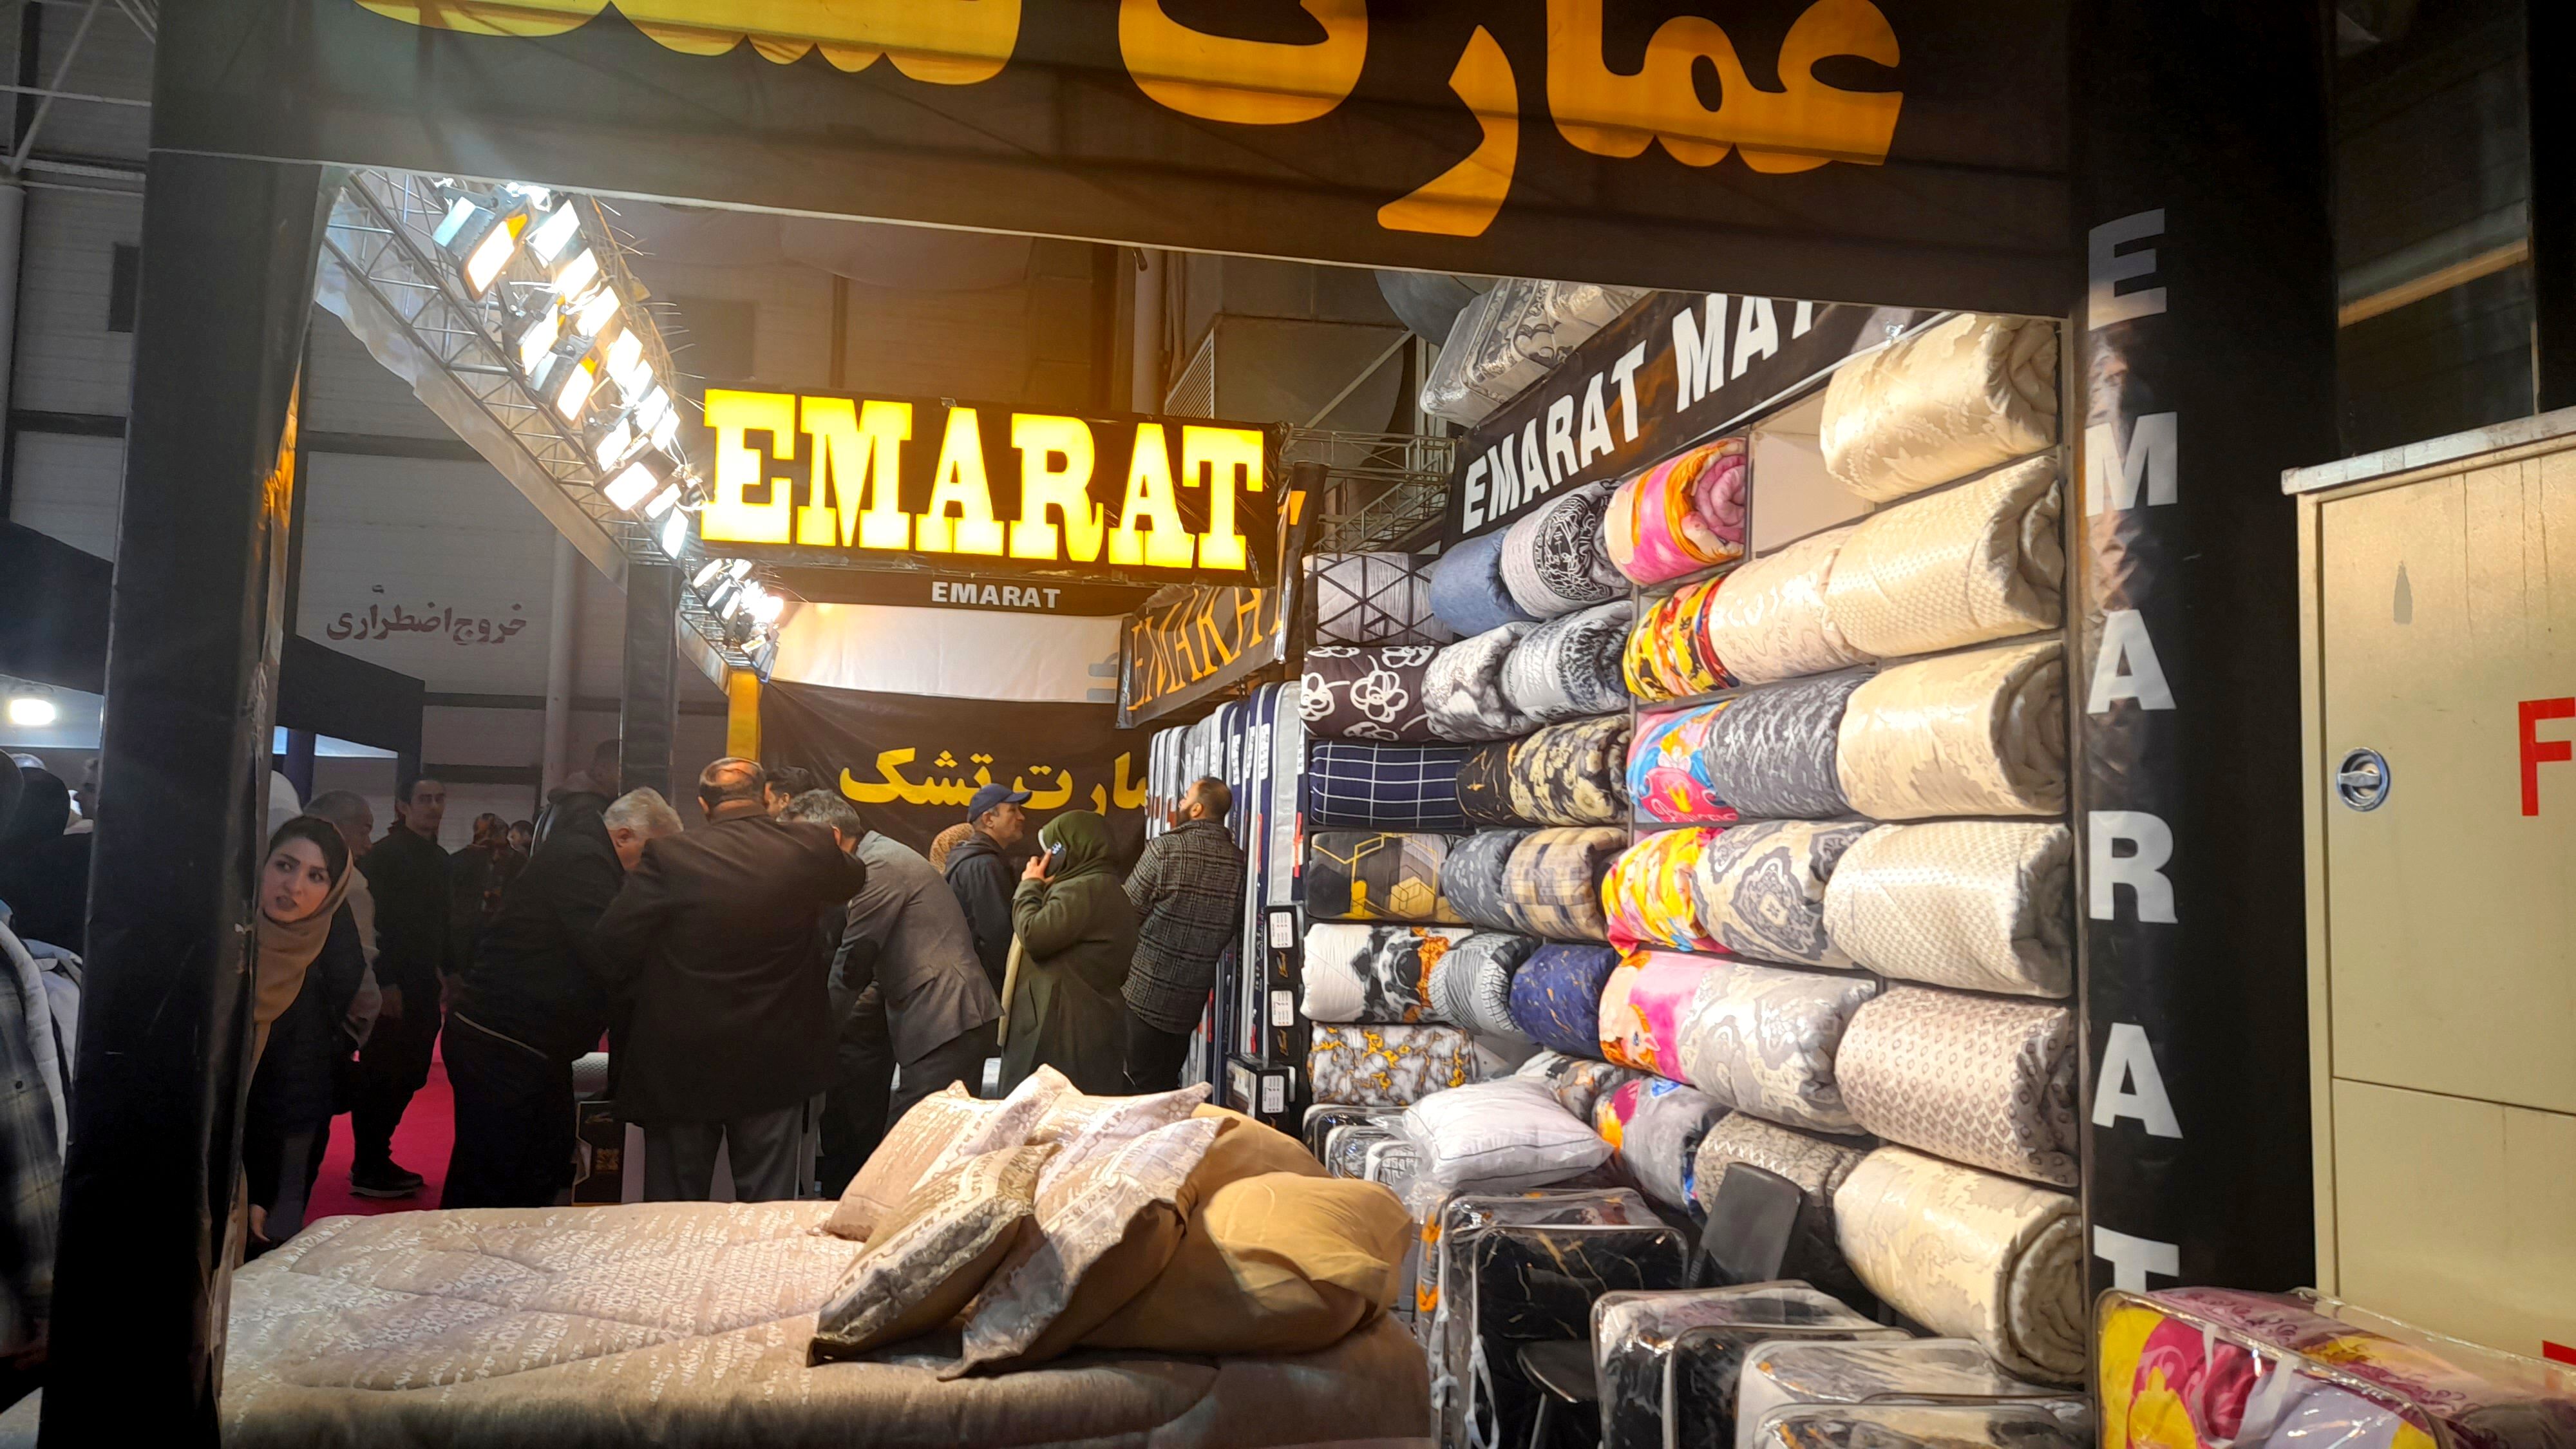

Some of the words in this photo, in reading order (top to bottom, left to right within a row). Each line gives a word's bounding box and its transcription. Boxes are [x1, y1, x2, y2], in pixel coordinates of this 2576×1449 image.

[1463, 340, 1647, 534] EMARAT
[701, 389, 1264, 571] EMARAT
[327, 601, 452, 640] اضطراری
[453, 603, 526, 645] خروج
[932, 582, 1061, 608] EMARAT
[839, 747, 993, 806] تشک
[2085, 208, 2183, 1293] EMARAT
